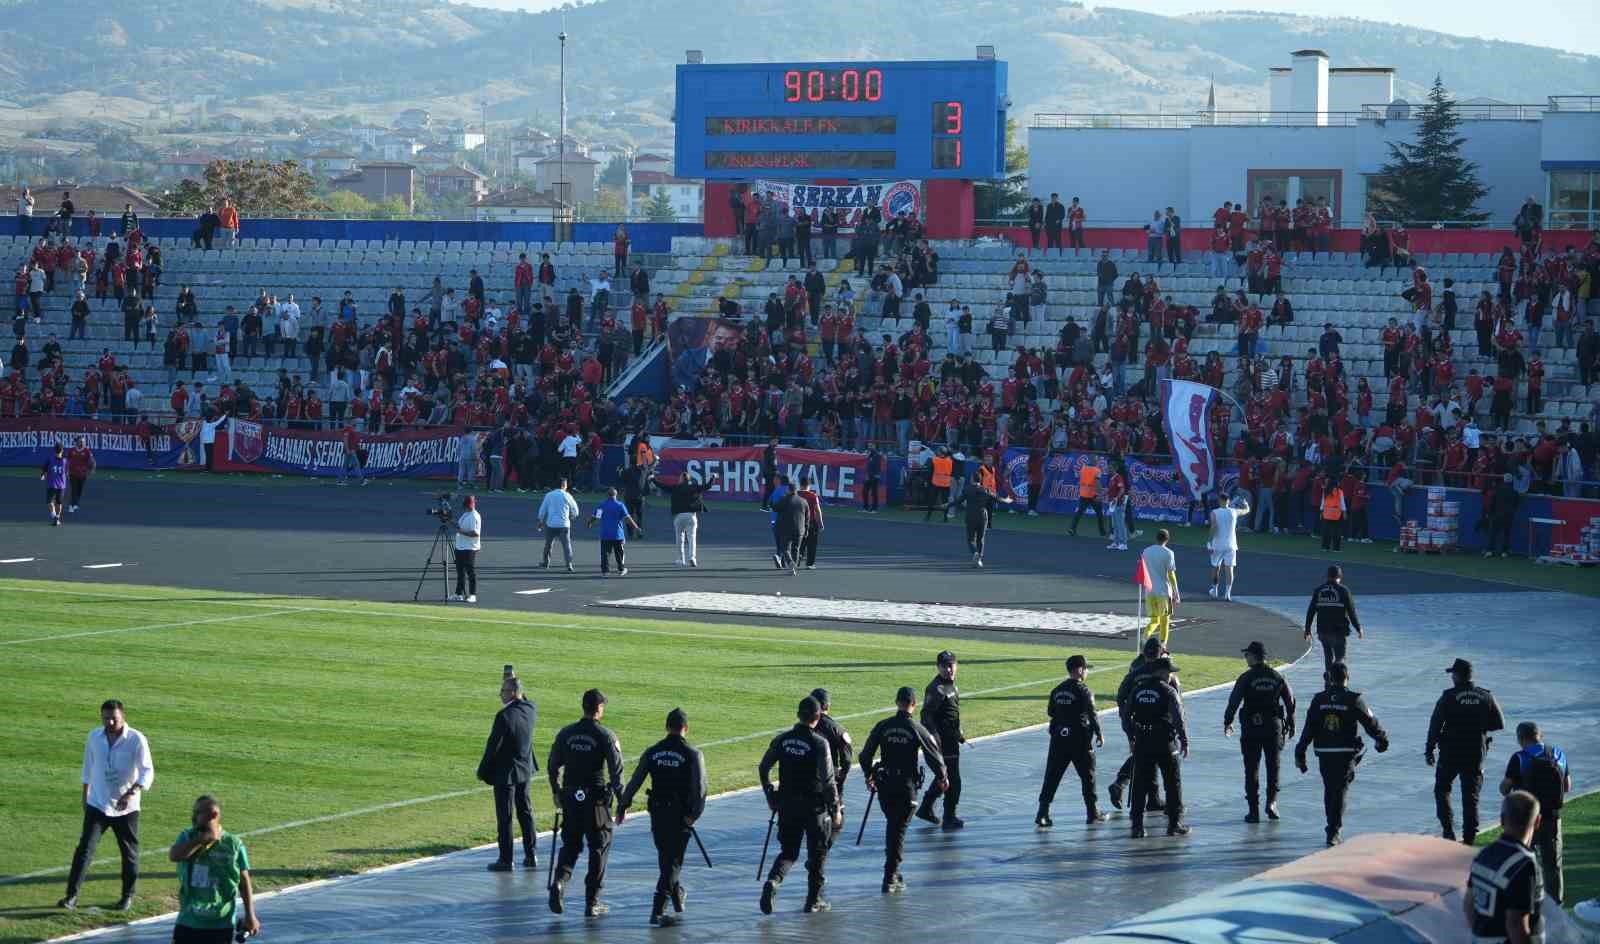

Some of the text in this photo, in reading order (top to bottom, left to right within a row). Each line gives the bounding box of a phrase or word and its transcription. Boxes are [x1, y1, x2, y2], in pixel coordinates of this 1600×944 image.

[785, 70, 882, 102] 90:00
[946, 102, 962, 134] 3
[954, 140, 961, 168] 1
[793, 184, 882, 207] SERKAN
[135, 434, 170, 452] KDAR
[786, 463, 857, 499] KALE
